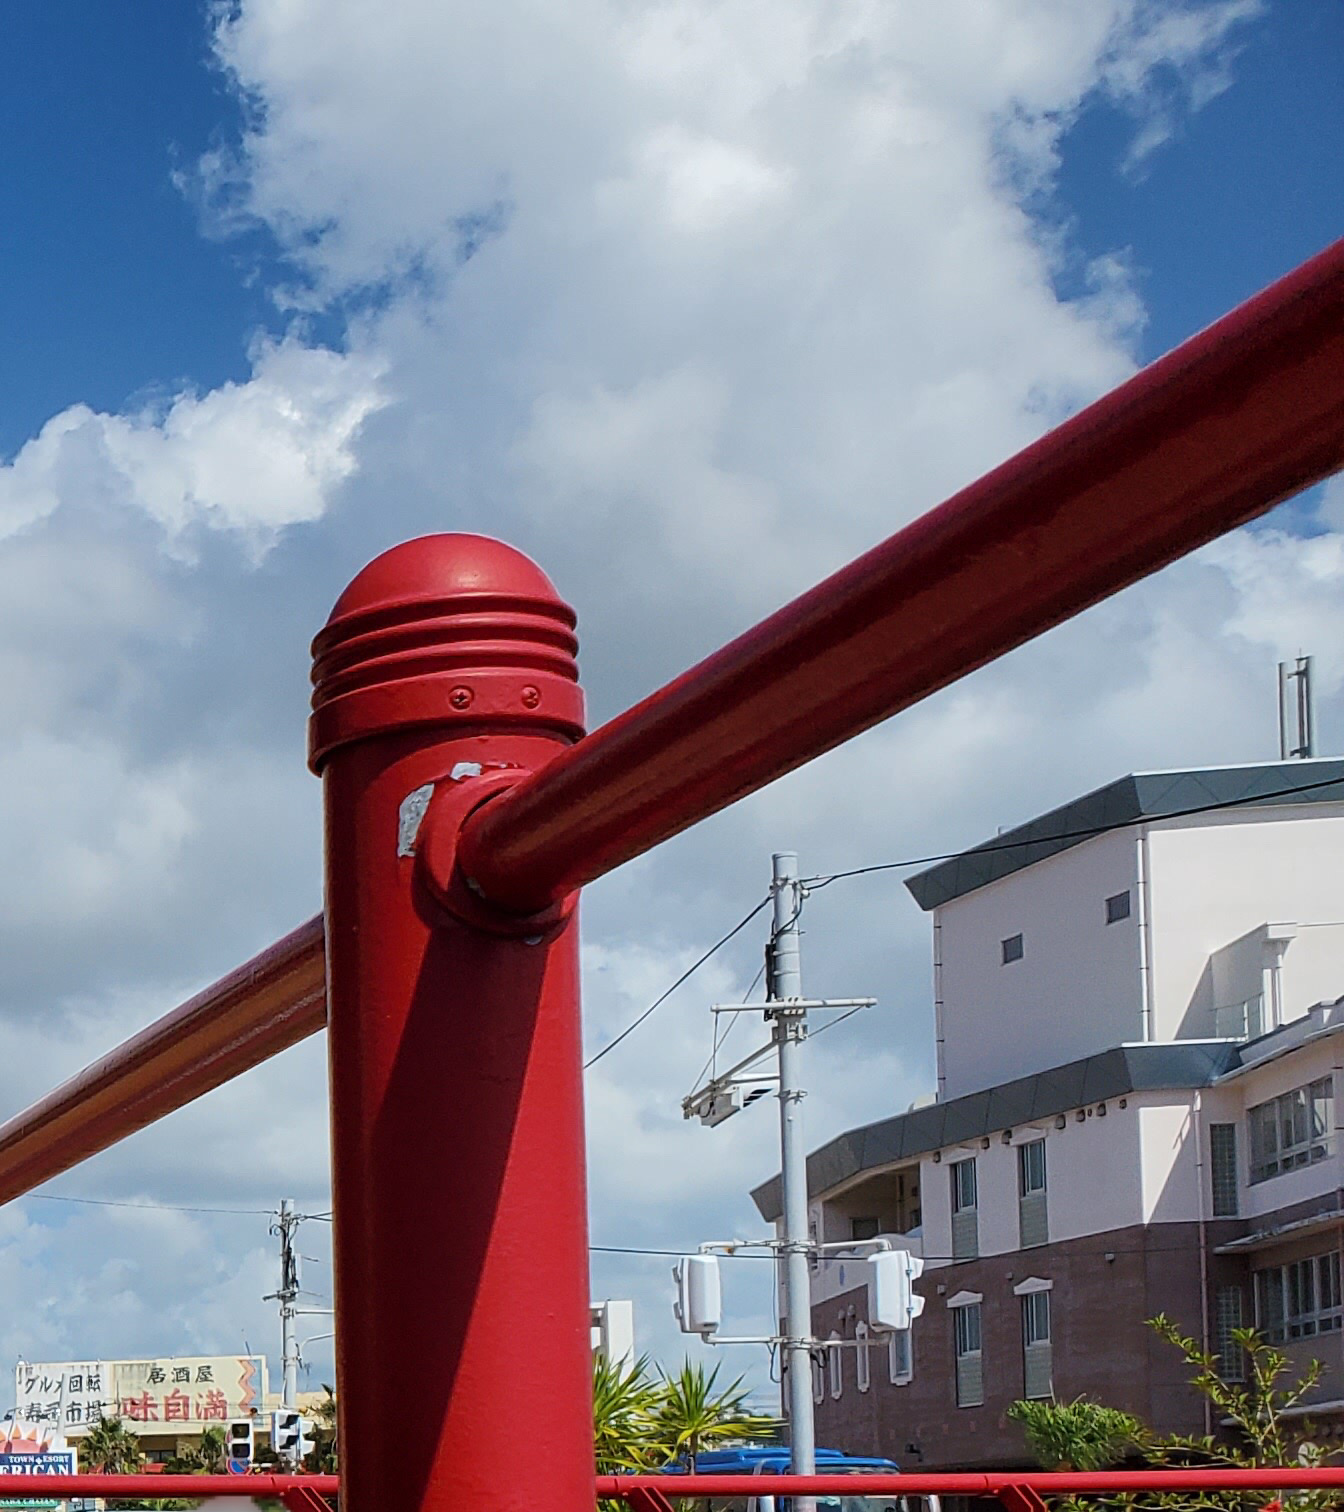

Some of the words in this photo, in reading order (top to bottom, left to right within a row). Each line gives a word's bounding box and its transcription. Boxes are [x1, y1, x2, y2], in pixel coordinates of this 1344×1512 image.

[147, 1365, 214, 1383] 居酒屋
[120, 1388, 229, 1421] 味自満
[9, 1455, 34, 1463] TOWN
[42, 1455, 69, 1463] ESORT
